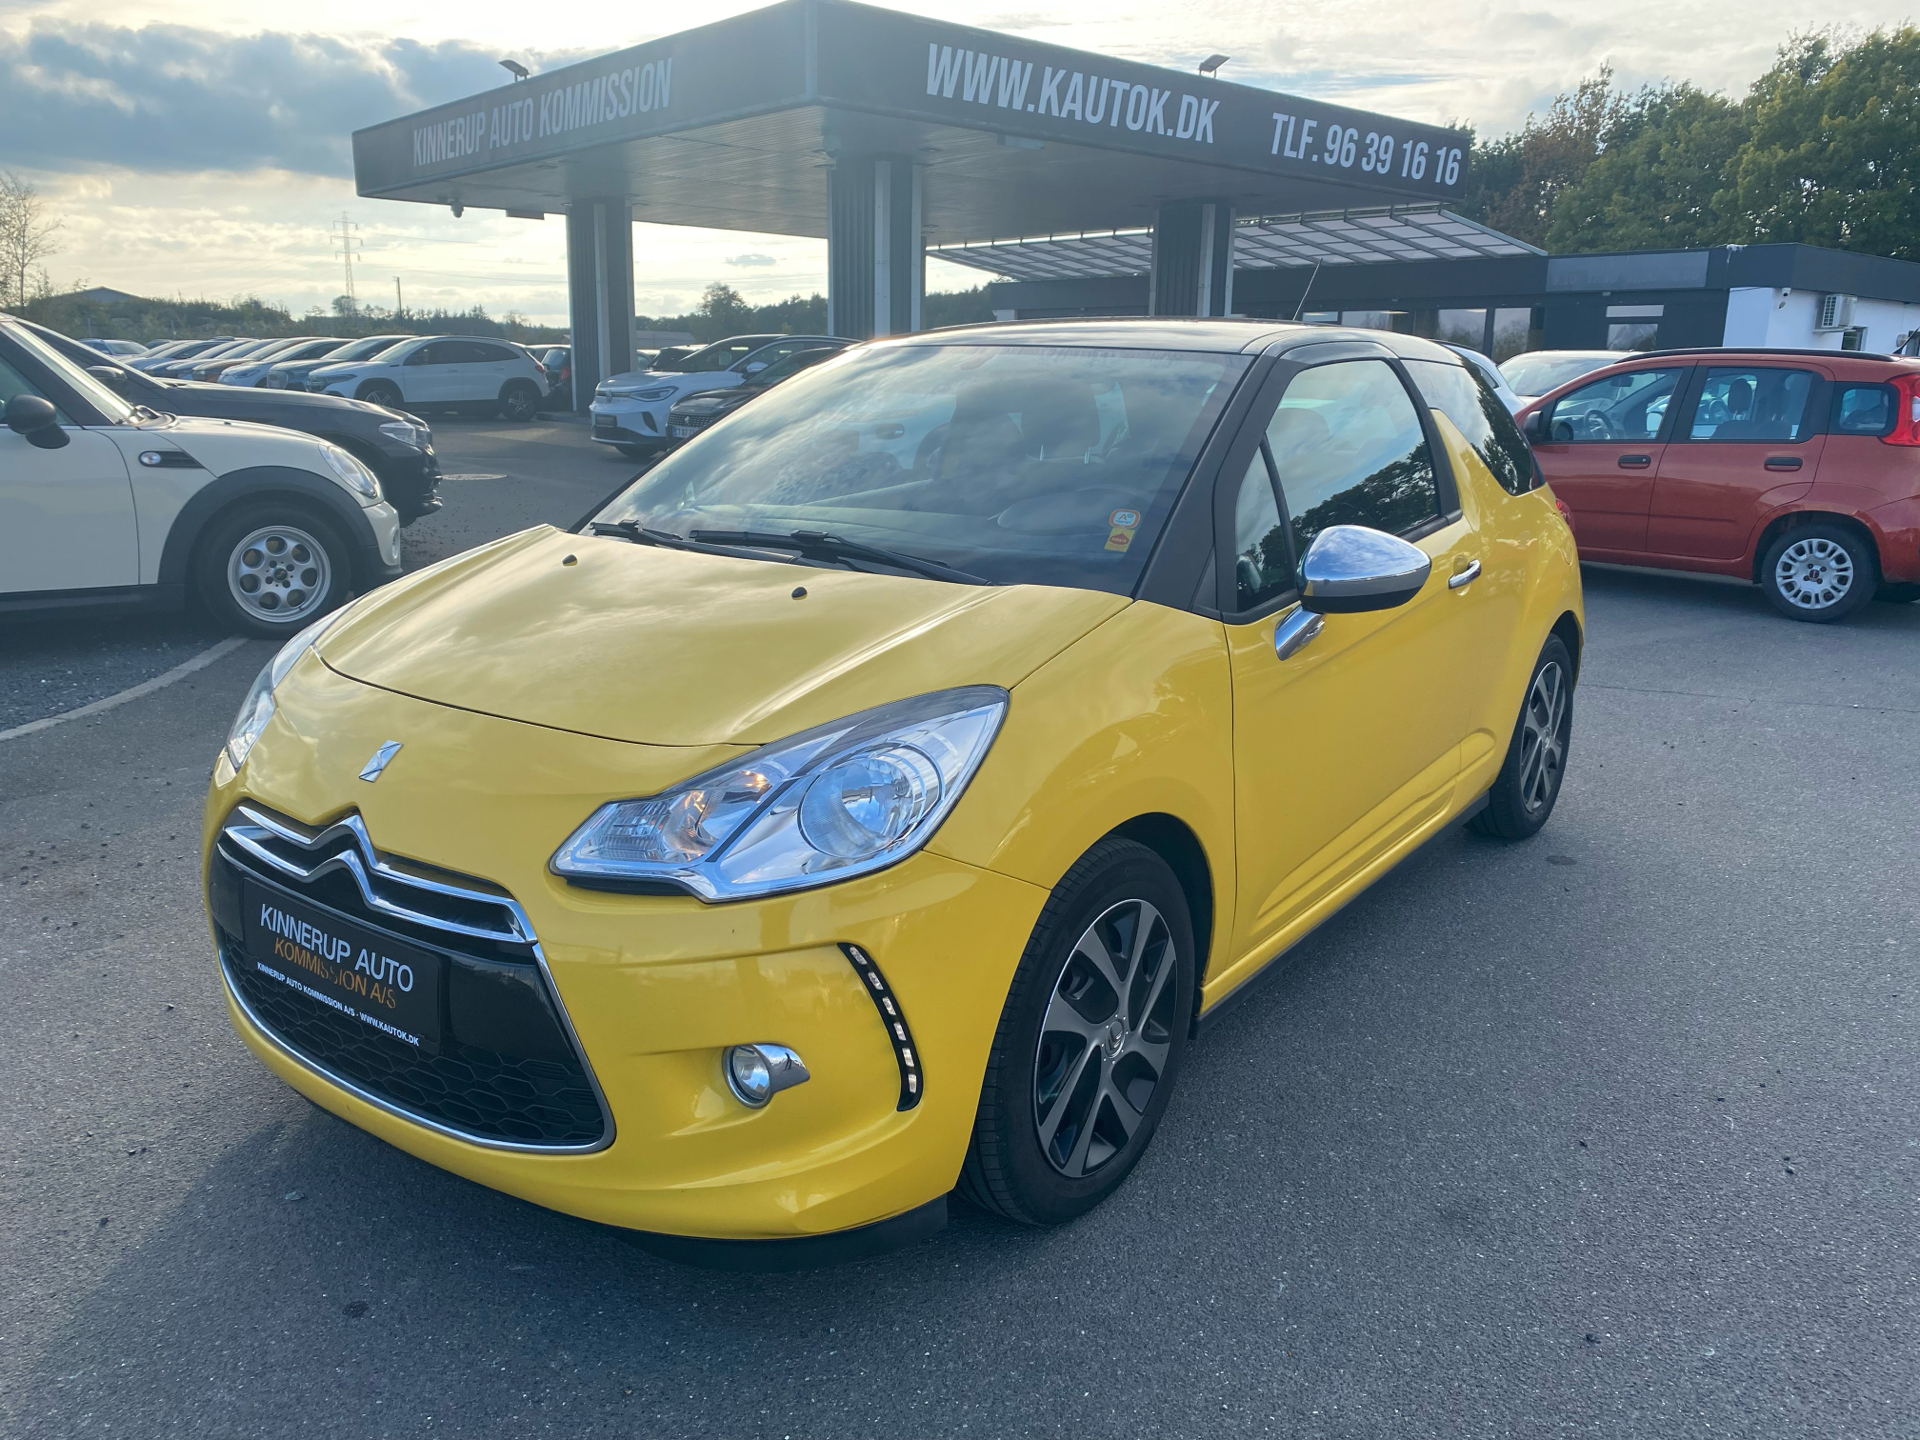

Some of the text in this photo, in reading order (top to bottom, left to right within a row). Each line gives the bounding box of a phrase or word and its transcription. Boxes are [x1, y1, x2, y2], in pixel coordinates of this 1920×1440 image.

[413, 57, 673, 168] KINNERUP AUTO KOMMISSION
[925, 43, 1221, 144] WWW.KAUTOK.DK
[1270, 111, 1462, 187] TLF. 96 39 16 16
[260, 903, 414, 992] KINNERUP AUTO
[274, 937, 396, 1009] KOMMISSION A/S
[257, 961, 286, 982] KINNERUP
[286, 978, 303, 991] AUTO
[303, 985, 343, 1011] KOMMISSION
[343, 1003, 355, 1017] A/S
[359, 1011, 420, 1047] WWW.KAUTOK.DK
